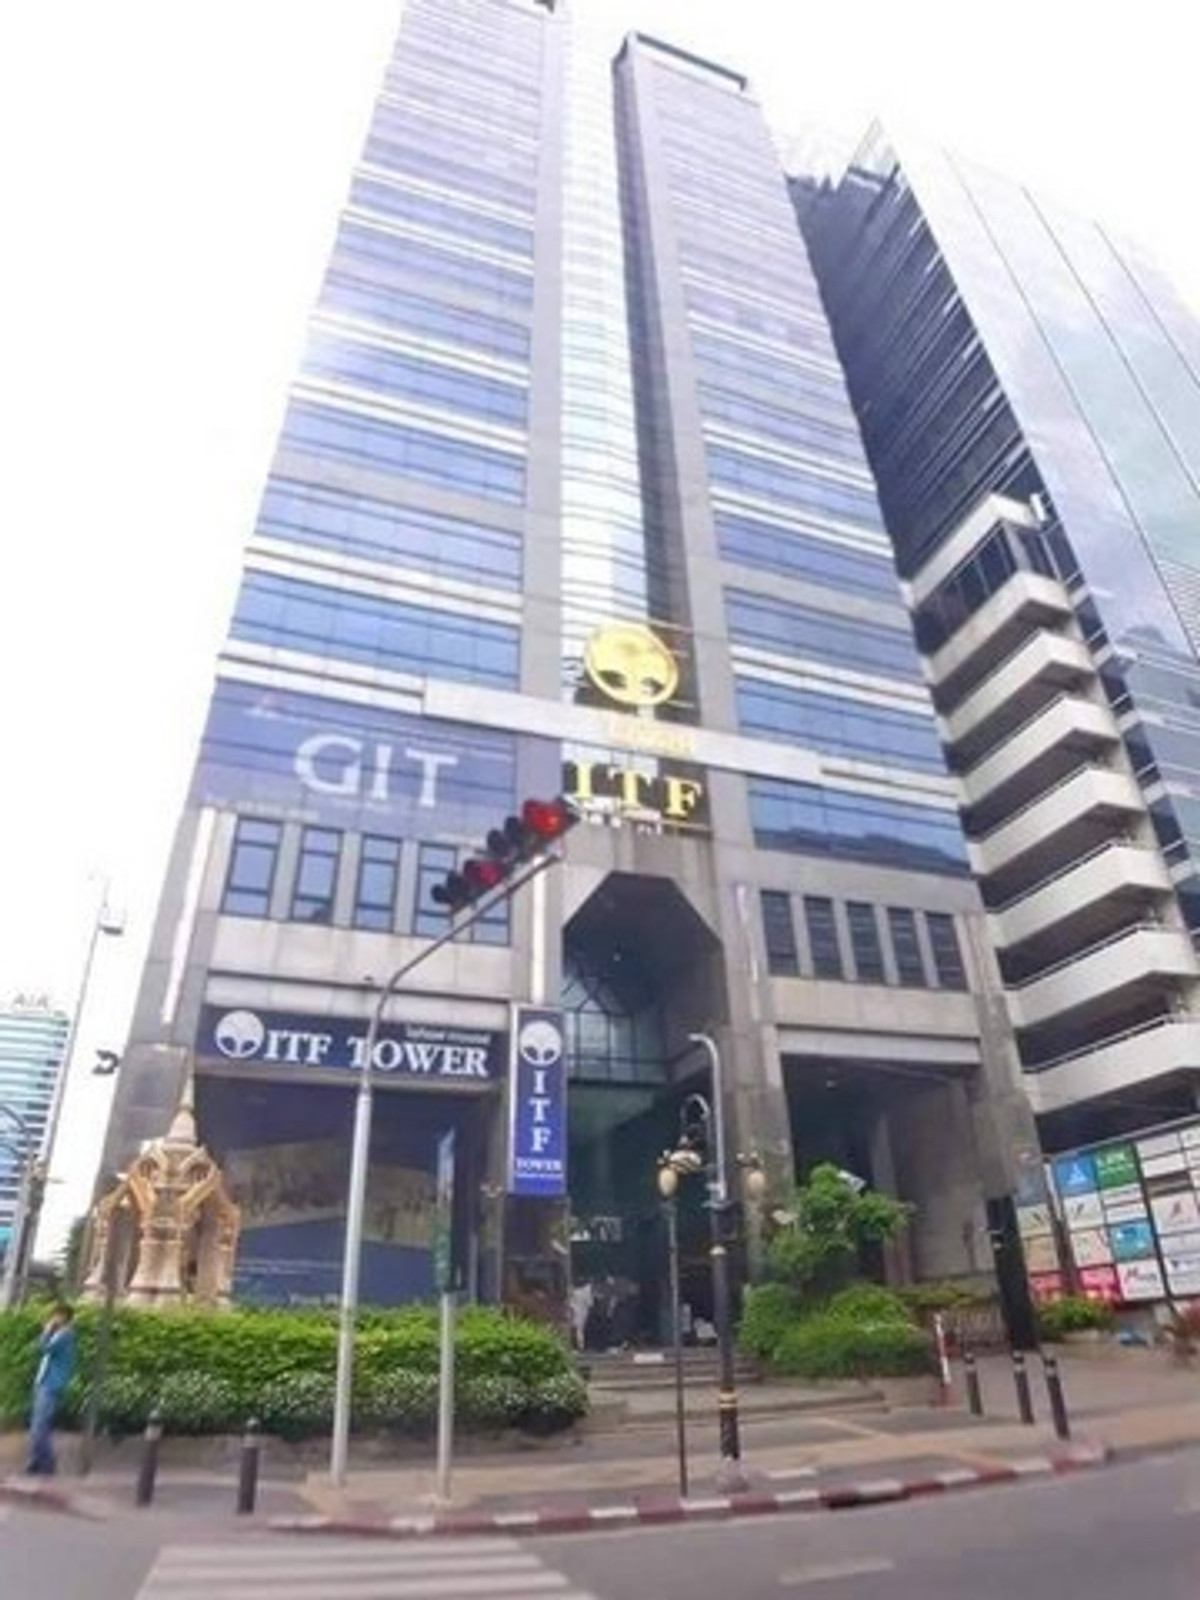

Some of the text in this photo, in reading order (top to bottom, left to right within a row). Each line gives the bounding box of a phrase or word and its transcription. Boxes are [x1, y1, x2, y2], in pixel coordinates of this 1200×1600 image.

[293, 733, 459, 809] GIT
[571, 760, 703, 817] ITF
[263, 1029, 332, 1065] ITF
[346, 1034, 490, 1078] TOWER
[515, 1156, 563, 1173] TOWER
